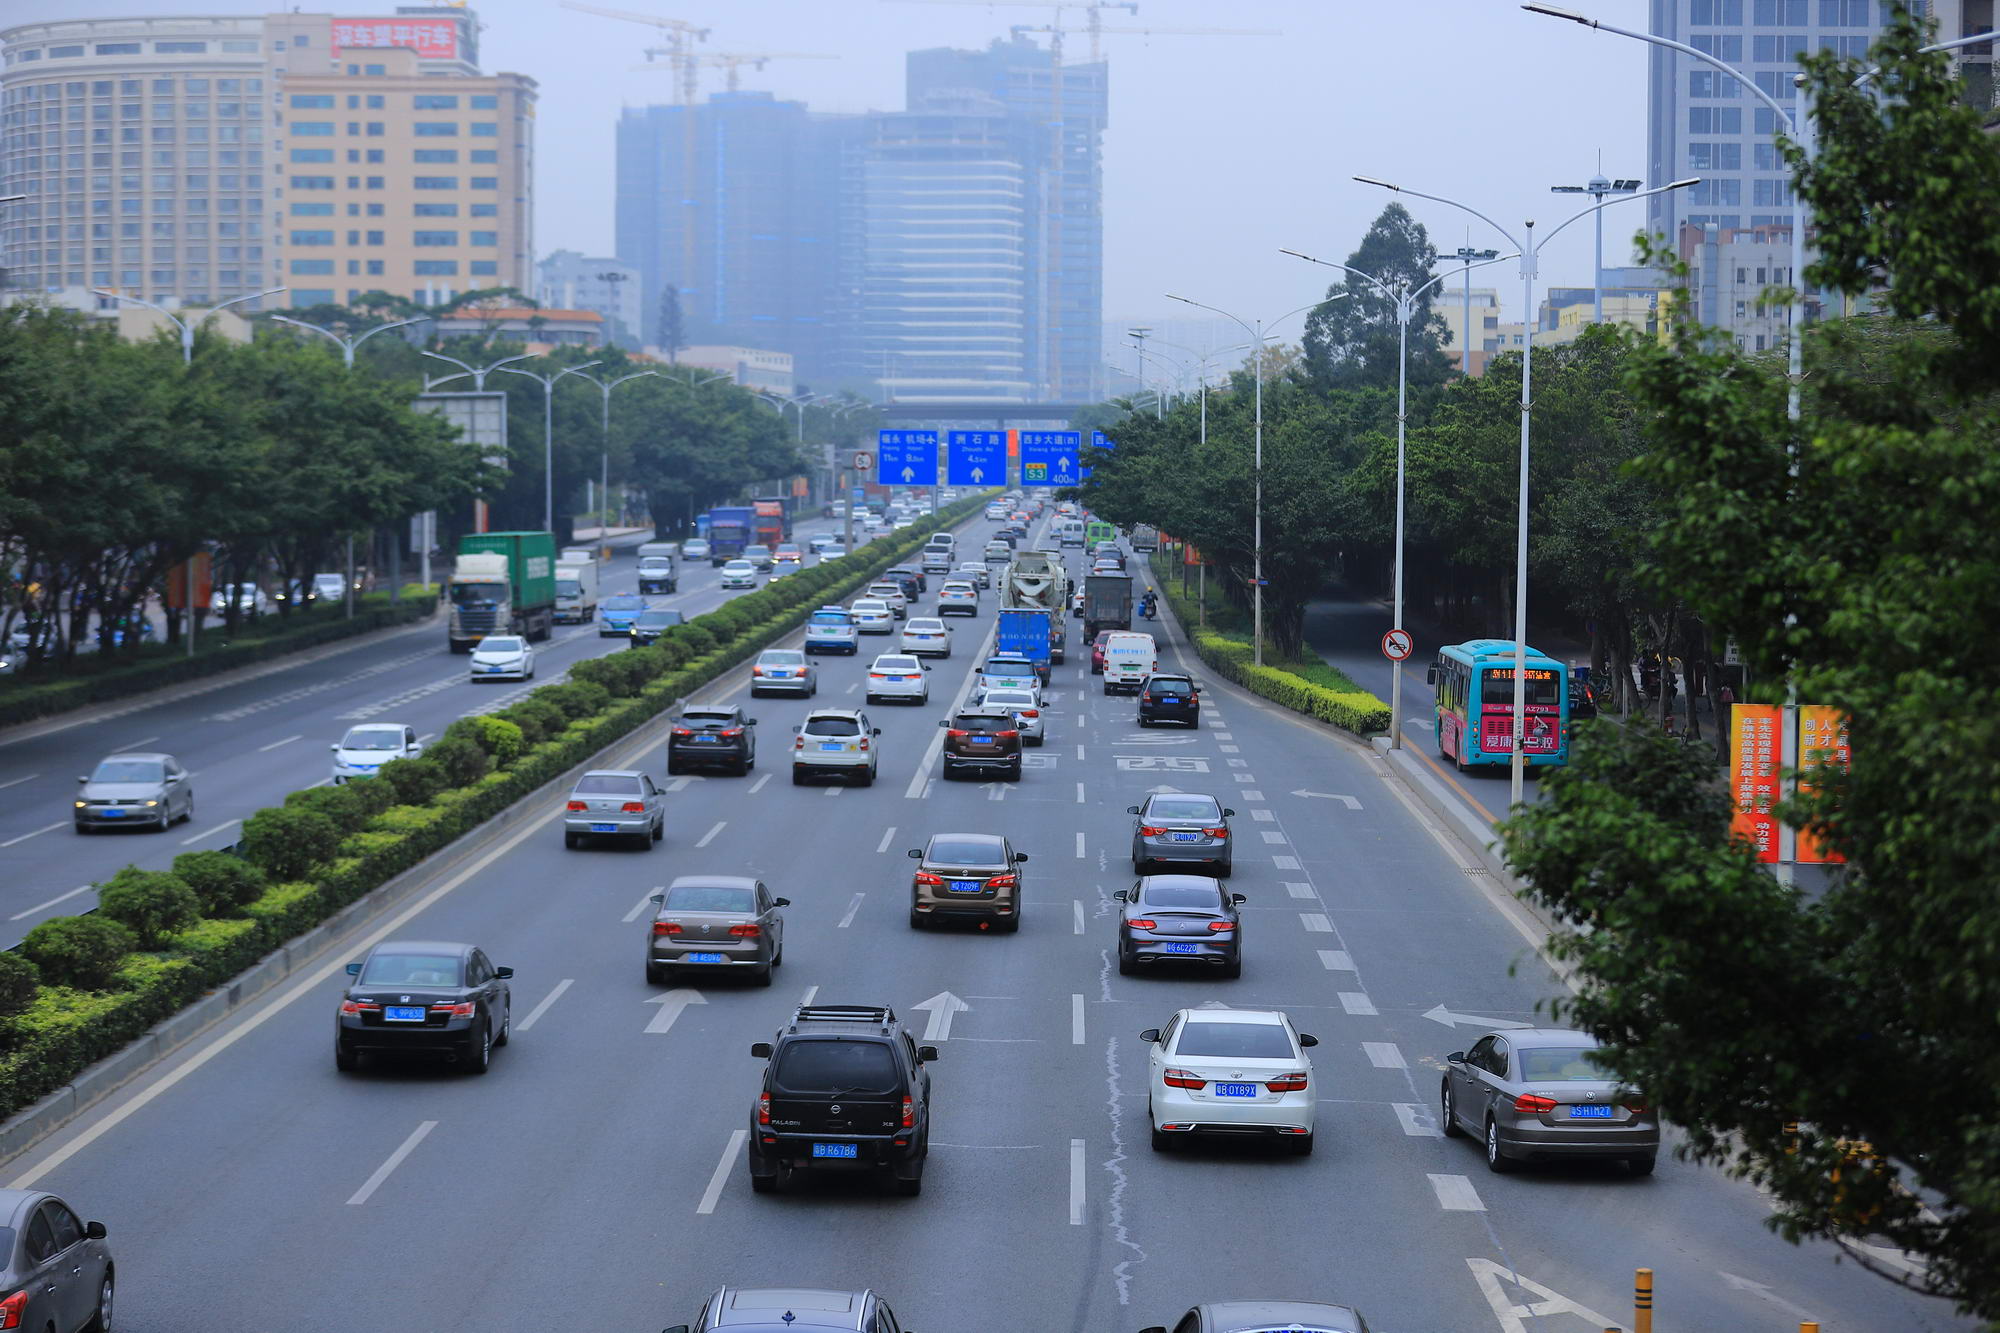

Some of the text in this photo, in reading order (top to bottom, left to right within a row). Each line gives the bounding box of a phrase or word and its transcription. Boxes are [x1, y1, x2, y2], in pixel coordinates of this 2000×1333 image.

[1028, 469, 1044, 479] S3
[1486, 735, 1553, 748] 爱康口腔
